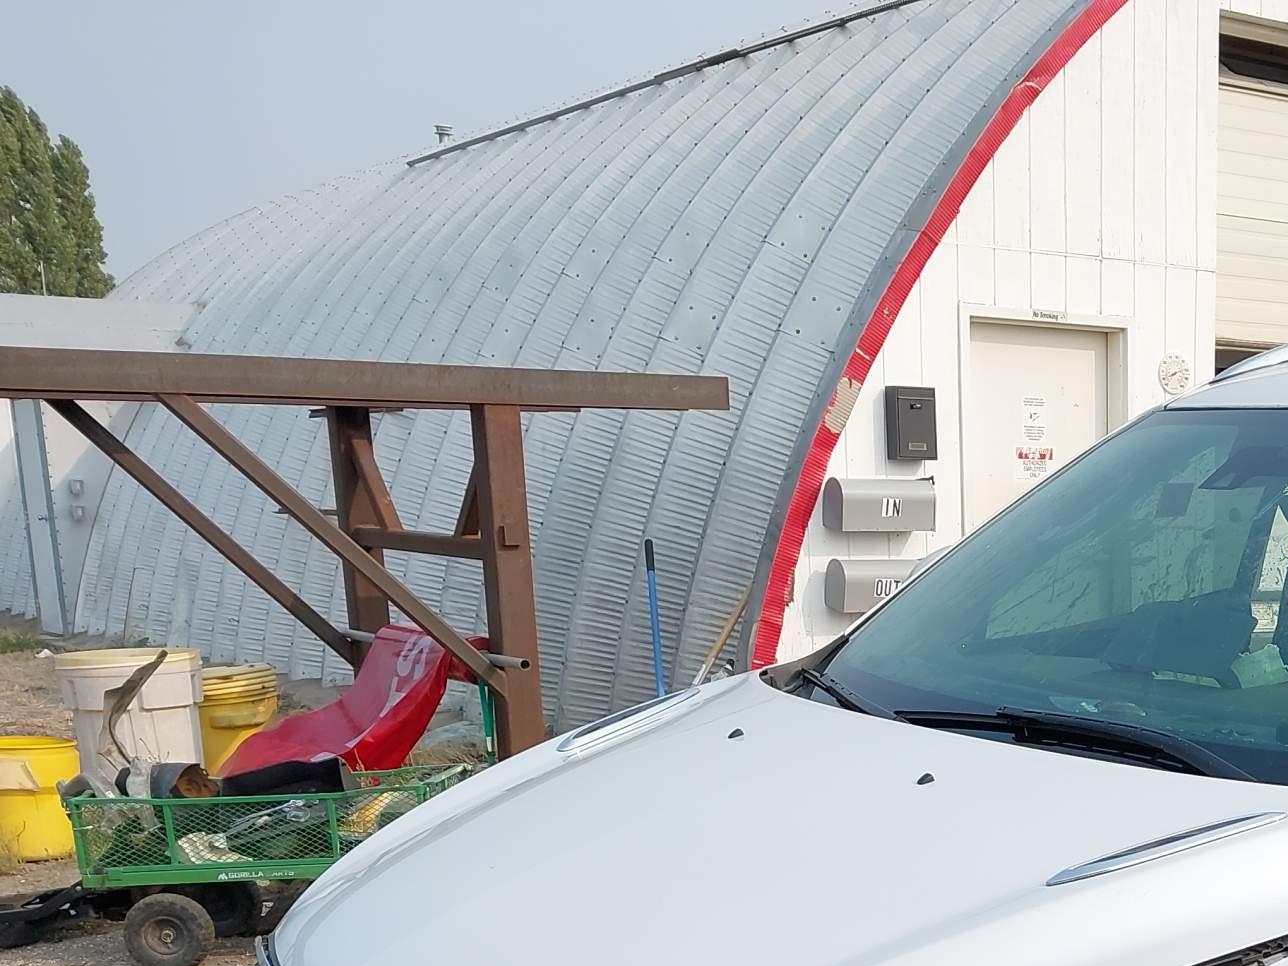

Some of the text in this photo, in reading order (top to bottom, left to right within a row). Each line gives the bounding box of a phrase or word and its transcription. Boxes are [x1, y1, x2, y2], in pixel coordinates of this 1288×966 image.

[885, 499, 901, 517] IN
[875, 580, 901, 597] OUT
[228, 871, 264, 879] GORILLA
